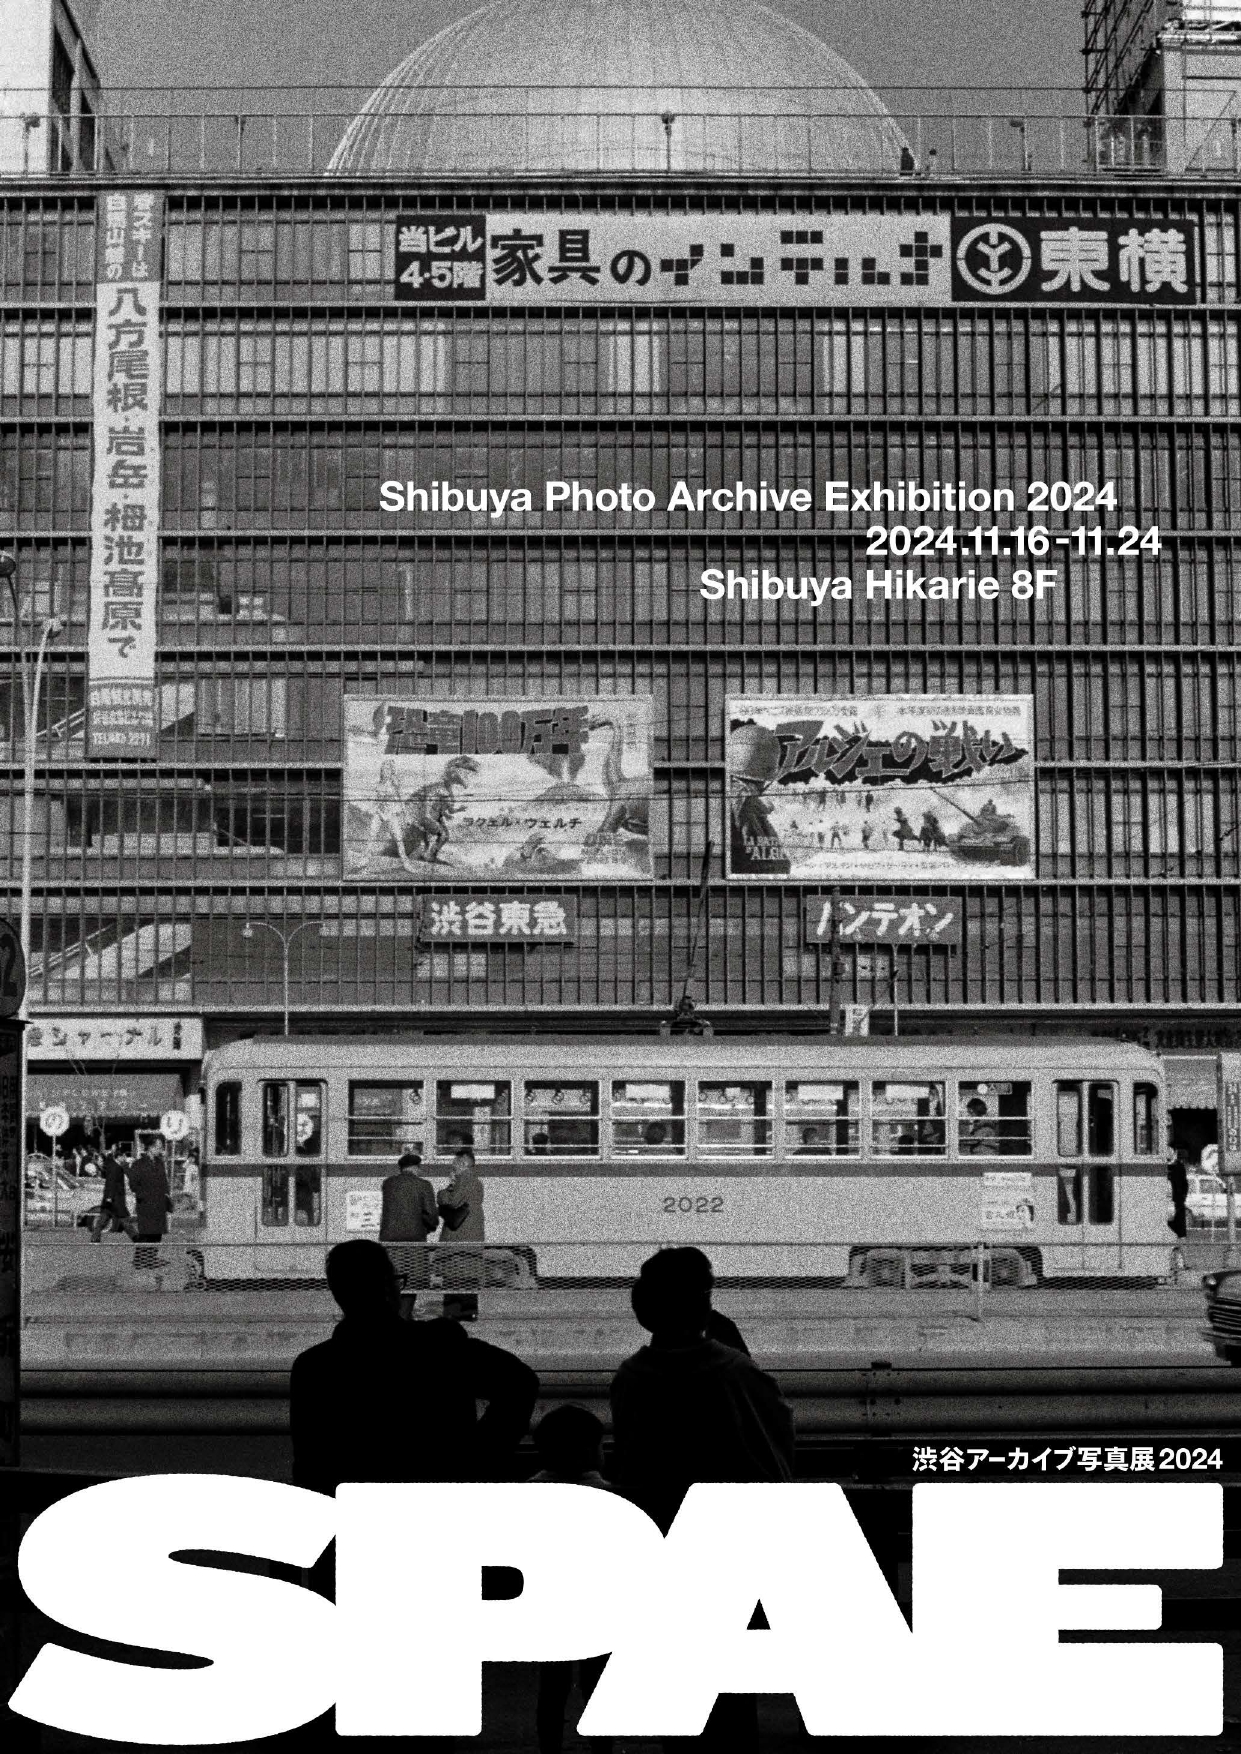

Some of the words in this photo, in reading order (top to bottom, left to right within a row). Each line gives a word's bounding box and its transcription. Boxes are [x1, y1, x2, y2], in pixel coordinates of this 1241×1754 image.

[398, 225, 484, 254] 当ビル
[1039, 226, 1189, 294] 東横
[764, 719, 1017, 788] アルジェの戦い
[431, 900, 567, 936] 渋谷東急
[663, 1196, 724, 1213] 2022
